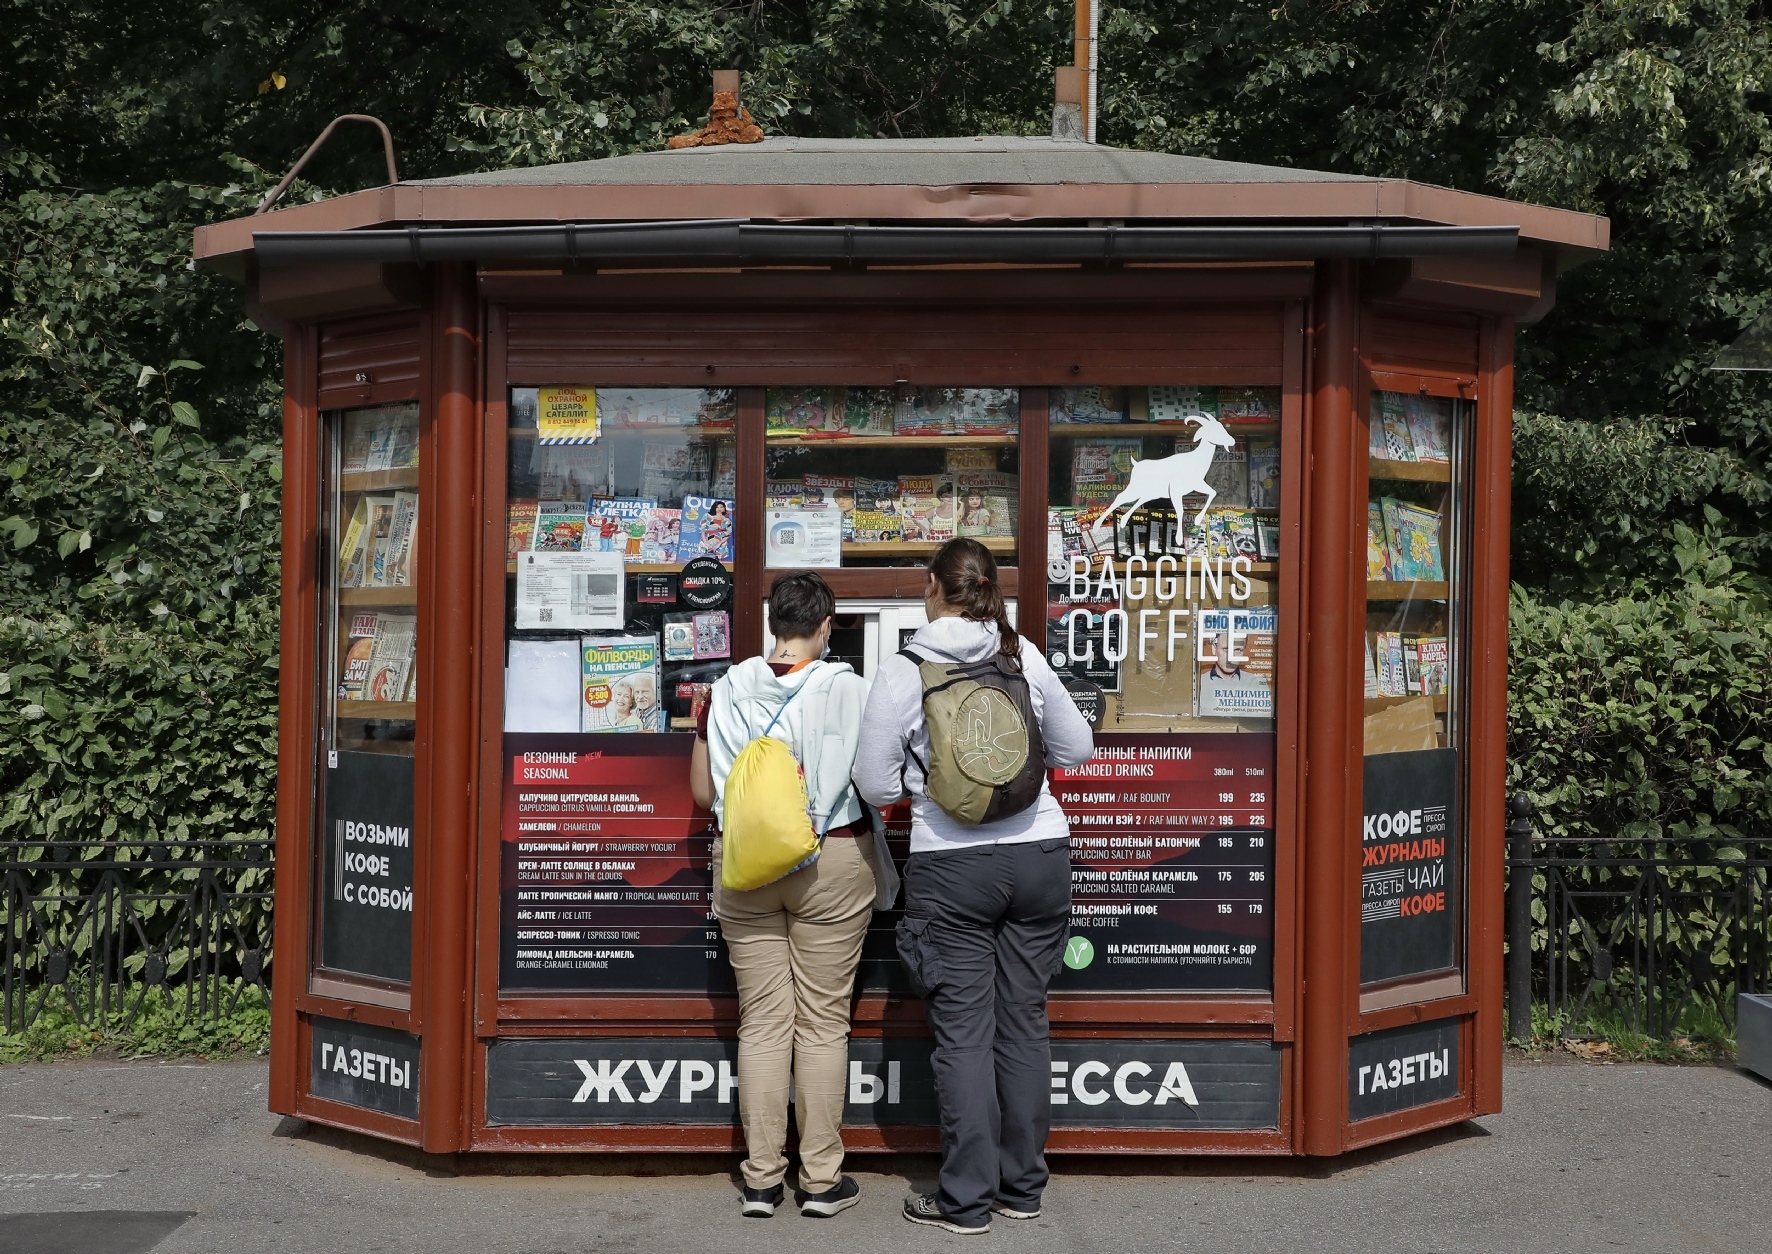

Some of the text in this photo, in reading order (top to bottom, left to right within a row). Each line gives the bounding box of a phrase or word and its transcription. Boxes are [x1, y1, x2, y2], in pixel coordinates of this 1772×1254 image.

[548, 394, 588, 402] ОХРАНОЙ
[1214, 452, 1244, 460] ХИВЫ
[902, 480, 932, 488] ЛЮДИ
[593, 500, 650, 509] КРУПНАЯ
[685, 577, 710, 586] СКИДКА
[1069, 556, 1252, 600] BAGGINS
[1204, 614, 1275, 630] БИОРАФИЯ
[1068, 608, 1250, 662] COFFEE
[1422, 642, 1446, 652] КЛЮЧ
[585, 648, 653, 664] ФИЛВОРДЫ
[1422, 651, 1448, 662] ВОРДЫ
[590, 662, 641, 672] НА ПЕНСИИ
[1214, 690, 1272, 699] ВЛАДИМИР
[1218, 699, 1272, 707] МЕНЬШОВ
[523, 752, 577, 764] СЕЗОННЫЕ
[584, 751, 603, 762] NEW
[1091, 747, 1192, 760] МЕННЫЕ НАПИТКИ
[523, 768, 569, 779] SEASONAL
[1064, 764, 1264, 777] BRANDED DRINKS 380ml 510ml
[519, 793, 640, 803] КАПУЧИНО ЦИТРУСОВАЯ ВАНИЛЬ
[1062, 793, 1265, 803] РАФ БАУНТИ RAF BOUNTY 199 235
[519, 804, 654, 813] CAPPUCCINO CITRUS VANILLA (COLD/HOT)
[1082, 814, 1265, 825] МИЛКИ ВЭЙ 2 RAF MILKY WAY 2 195 225
[1363, 809, 1445, 840] КОФЕ ПРЕССА
[519, 823, 601, 831] ХАМЕЛЕОН CHAMELEON
[1426, 823, 1445, 833] СИРОП
[345, 821, 409, 848] ВОЗЬМИ
[518, 842, 676, 852] КЛУБНИЧНЫЙ ЙОГУРТ STRAWBERRY YOGURT
[1110, 836, 1264, 848] СОЛЁНЫЙ БАТОНЧИК 185 210
[1111, 850, 1152, 860] SALTY BAR
[1363, 837, 1444, 867] ЖУРНАЛЫ
[344, 852, 390, 877] КОФЕ
[518, 862, 636, 871] КРЕМ-ЛАТТЕ СОЛНЦЕ В ОБЛАКАХ
[518, 872, 623, 880] CREAM LATTE SUN IN THE CLOUDS
[1071, 870, 1265, 881] ПУЧИНО СОЛЁНАЯ КАРАМЕЛЬ 175 205
[1362, 858, 1444, 898] ГАЗЕТЫ ЧАЙ
[1071, 884, 1175, 893] PPUCCINO SALTED CARAMEL
[344, 882, 413, 912] С СОБОЙ
[518, 890, 700, 901] ЛАТТЕ ТРОПИЧЕСКИЙ МАНГО TROPICAL MANGO LATTE
[1072, 903, 1263, 915] ЕЛЬСИНОВЫЙ КОФЕ 155 179
[1362, 892, 1445, 917] ПРЕССА СИРОП КОФЕ
[517, 910, 592, 920] АЙС-ЛАТТЕ ICE LATTE
[1068, 918, 1119, 927] RANGE COFFEE
[517, 931, 717, 940] ЭСПРЕССО-ТОНИК ESPRESSO TONIC 175
[1107, 945, 1119, 954] НА
[1122, 945, 1191, 954] РАСТИТЕЛЬНОМ
[1193, 945, 1230, 954] МОЛОКЕ
[516, 951, 717, 960] ЛИМОНАД АПЕЛЬСИН-КАРАМЕЛЬ 170
[1151, 956, 1178, 964] НАПИТКА
[1180, 955, 1216, 965] (УТОЧНЯЙТЕ
[1223, 956, 1252, 965] БАРИСТА)
[516, 960, 609, 969] ORANGE-CARAMEL LEMONADE
[321, 1042, 410, 1089] ГАЗЕТЫ
[1358, 1048, 1449, 1096] ГАЗЕТЫ
[572, 1059, 900, 1104] ЖУРНЫ
[1050, 1060, 1199, 1106] ЕССА
